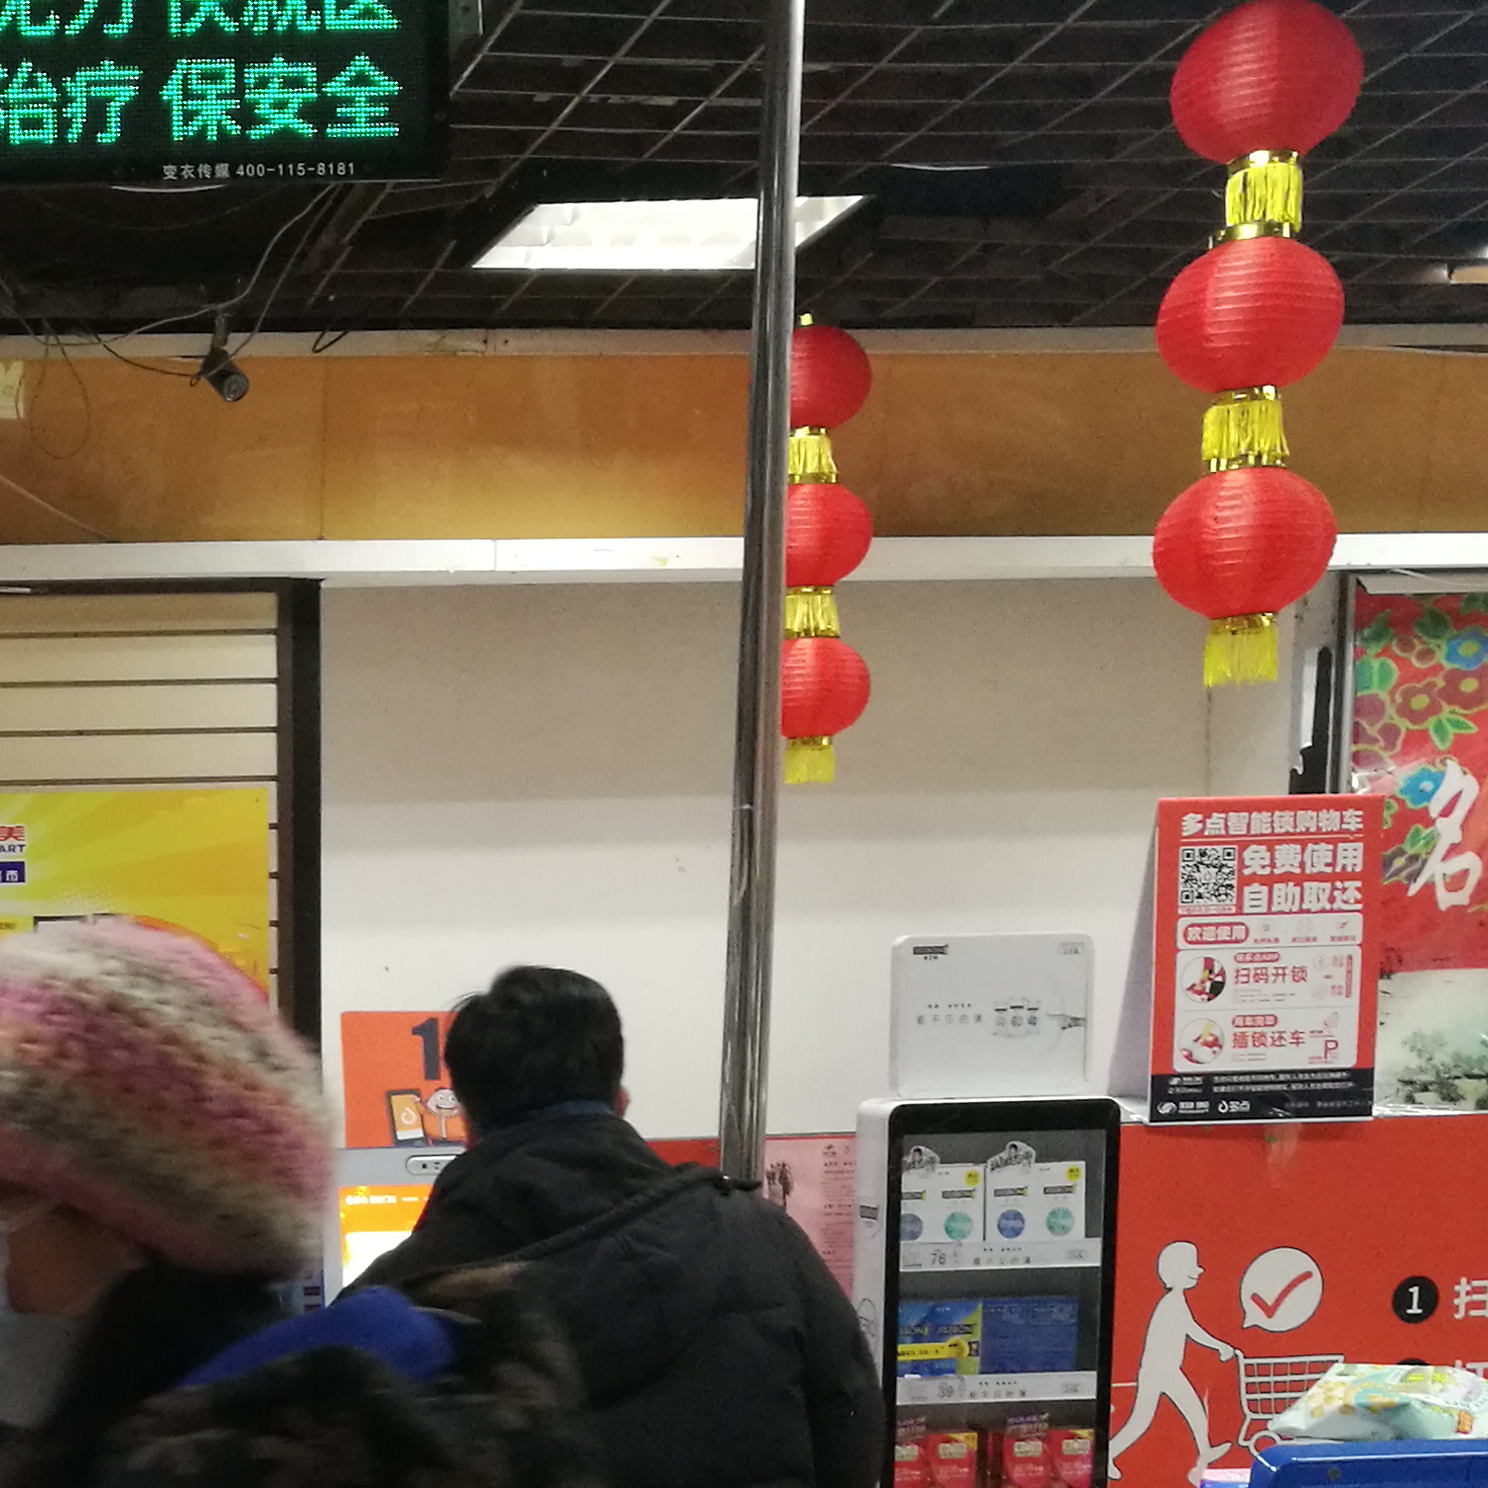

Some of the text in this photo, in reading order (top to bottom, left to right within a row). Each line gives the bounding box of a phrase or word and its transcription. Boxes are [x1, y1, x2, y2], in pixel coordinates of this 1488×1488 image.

[158, 51, 404, 142] 保安全
[235, 161, 356, 177] 400-115-8181
[1181, 809, 1364, 836] 多点智能锁购物车
[1242, 842, 1364, 875] 免费使用
[1242, 880, 1362, 914] 自助取还
[1234, 965, 1308, 985] 扫码开锁
[1231, 1030, 1306, 1049] 插锁还车
